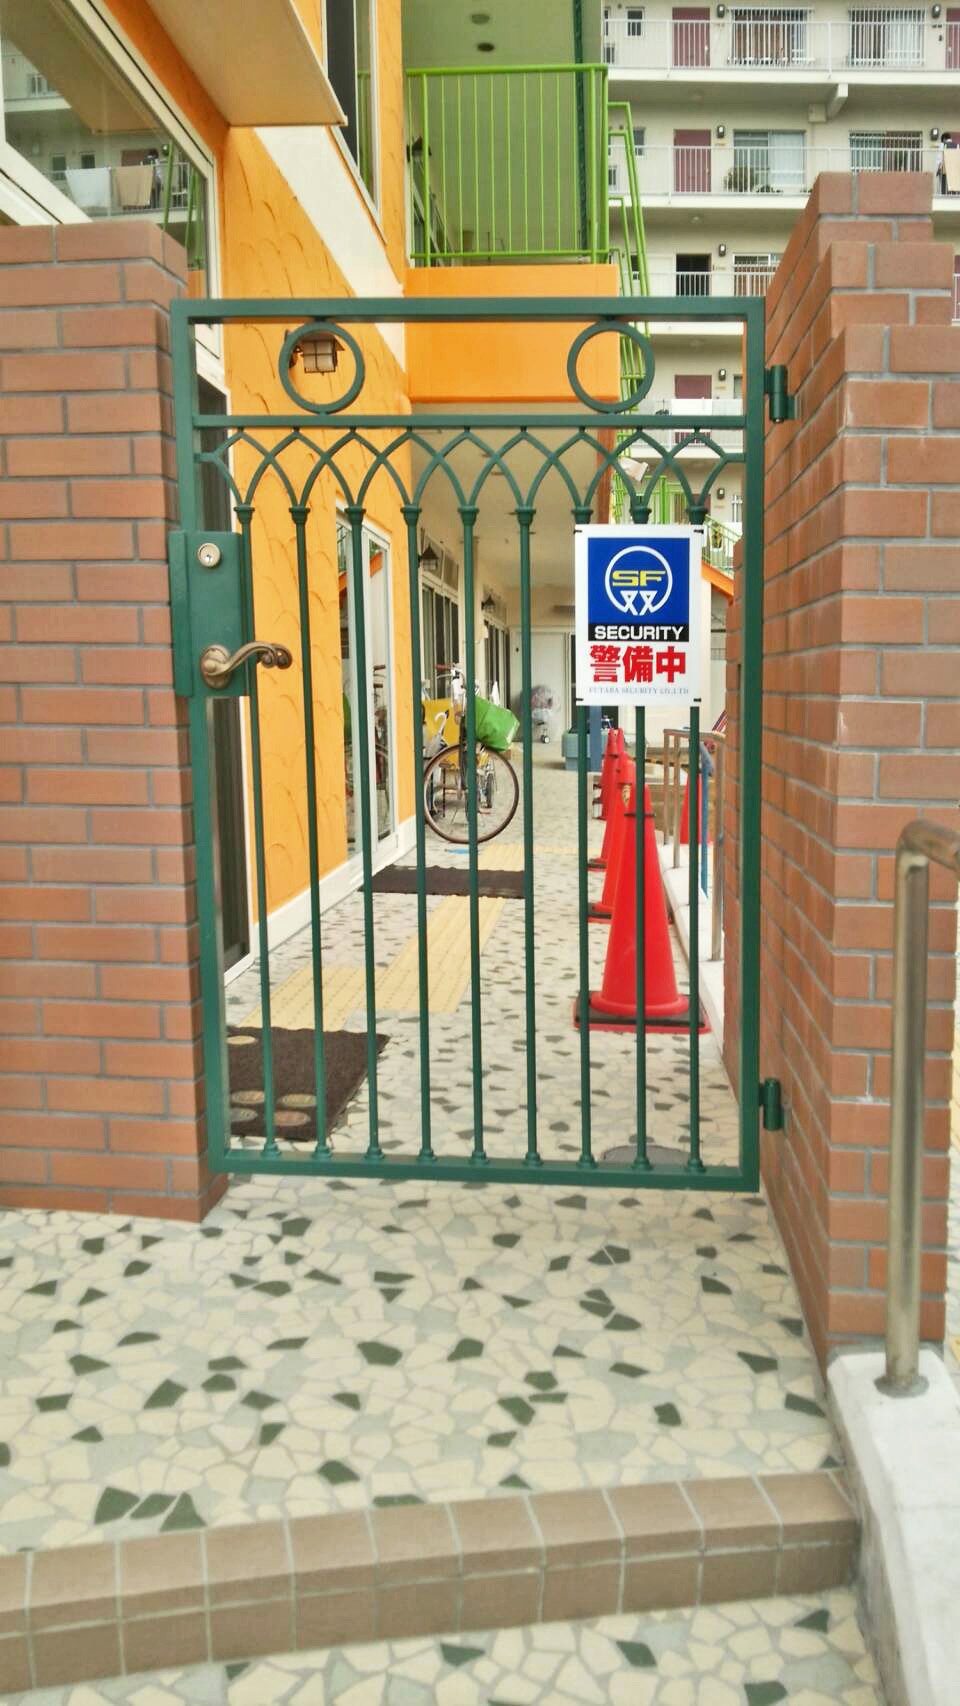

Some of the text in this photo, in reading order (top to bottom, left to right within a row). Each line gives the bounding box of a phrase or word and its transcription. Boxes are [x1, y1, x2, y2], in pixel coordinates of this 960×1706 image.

[612, 570, 666, 587] SF
[594, 625, 684, 641] SECURITY
[589, 644, 686, 683] 警備中
